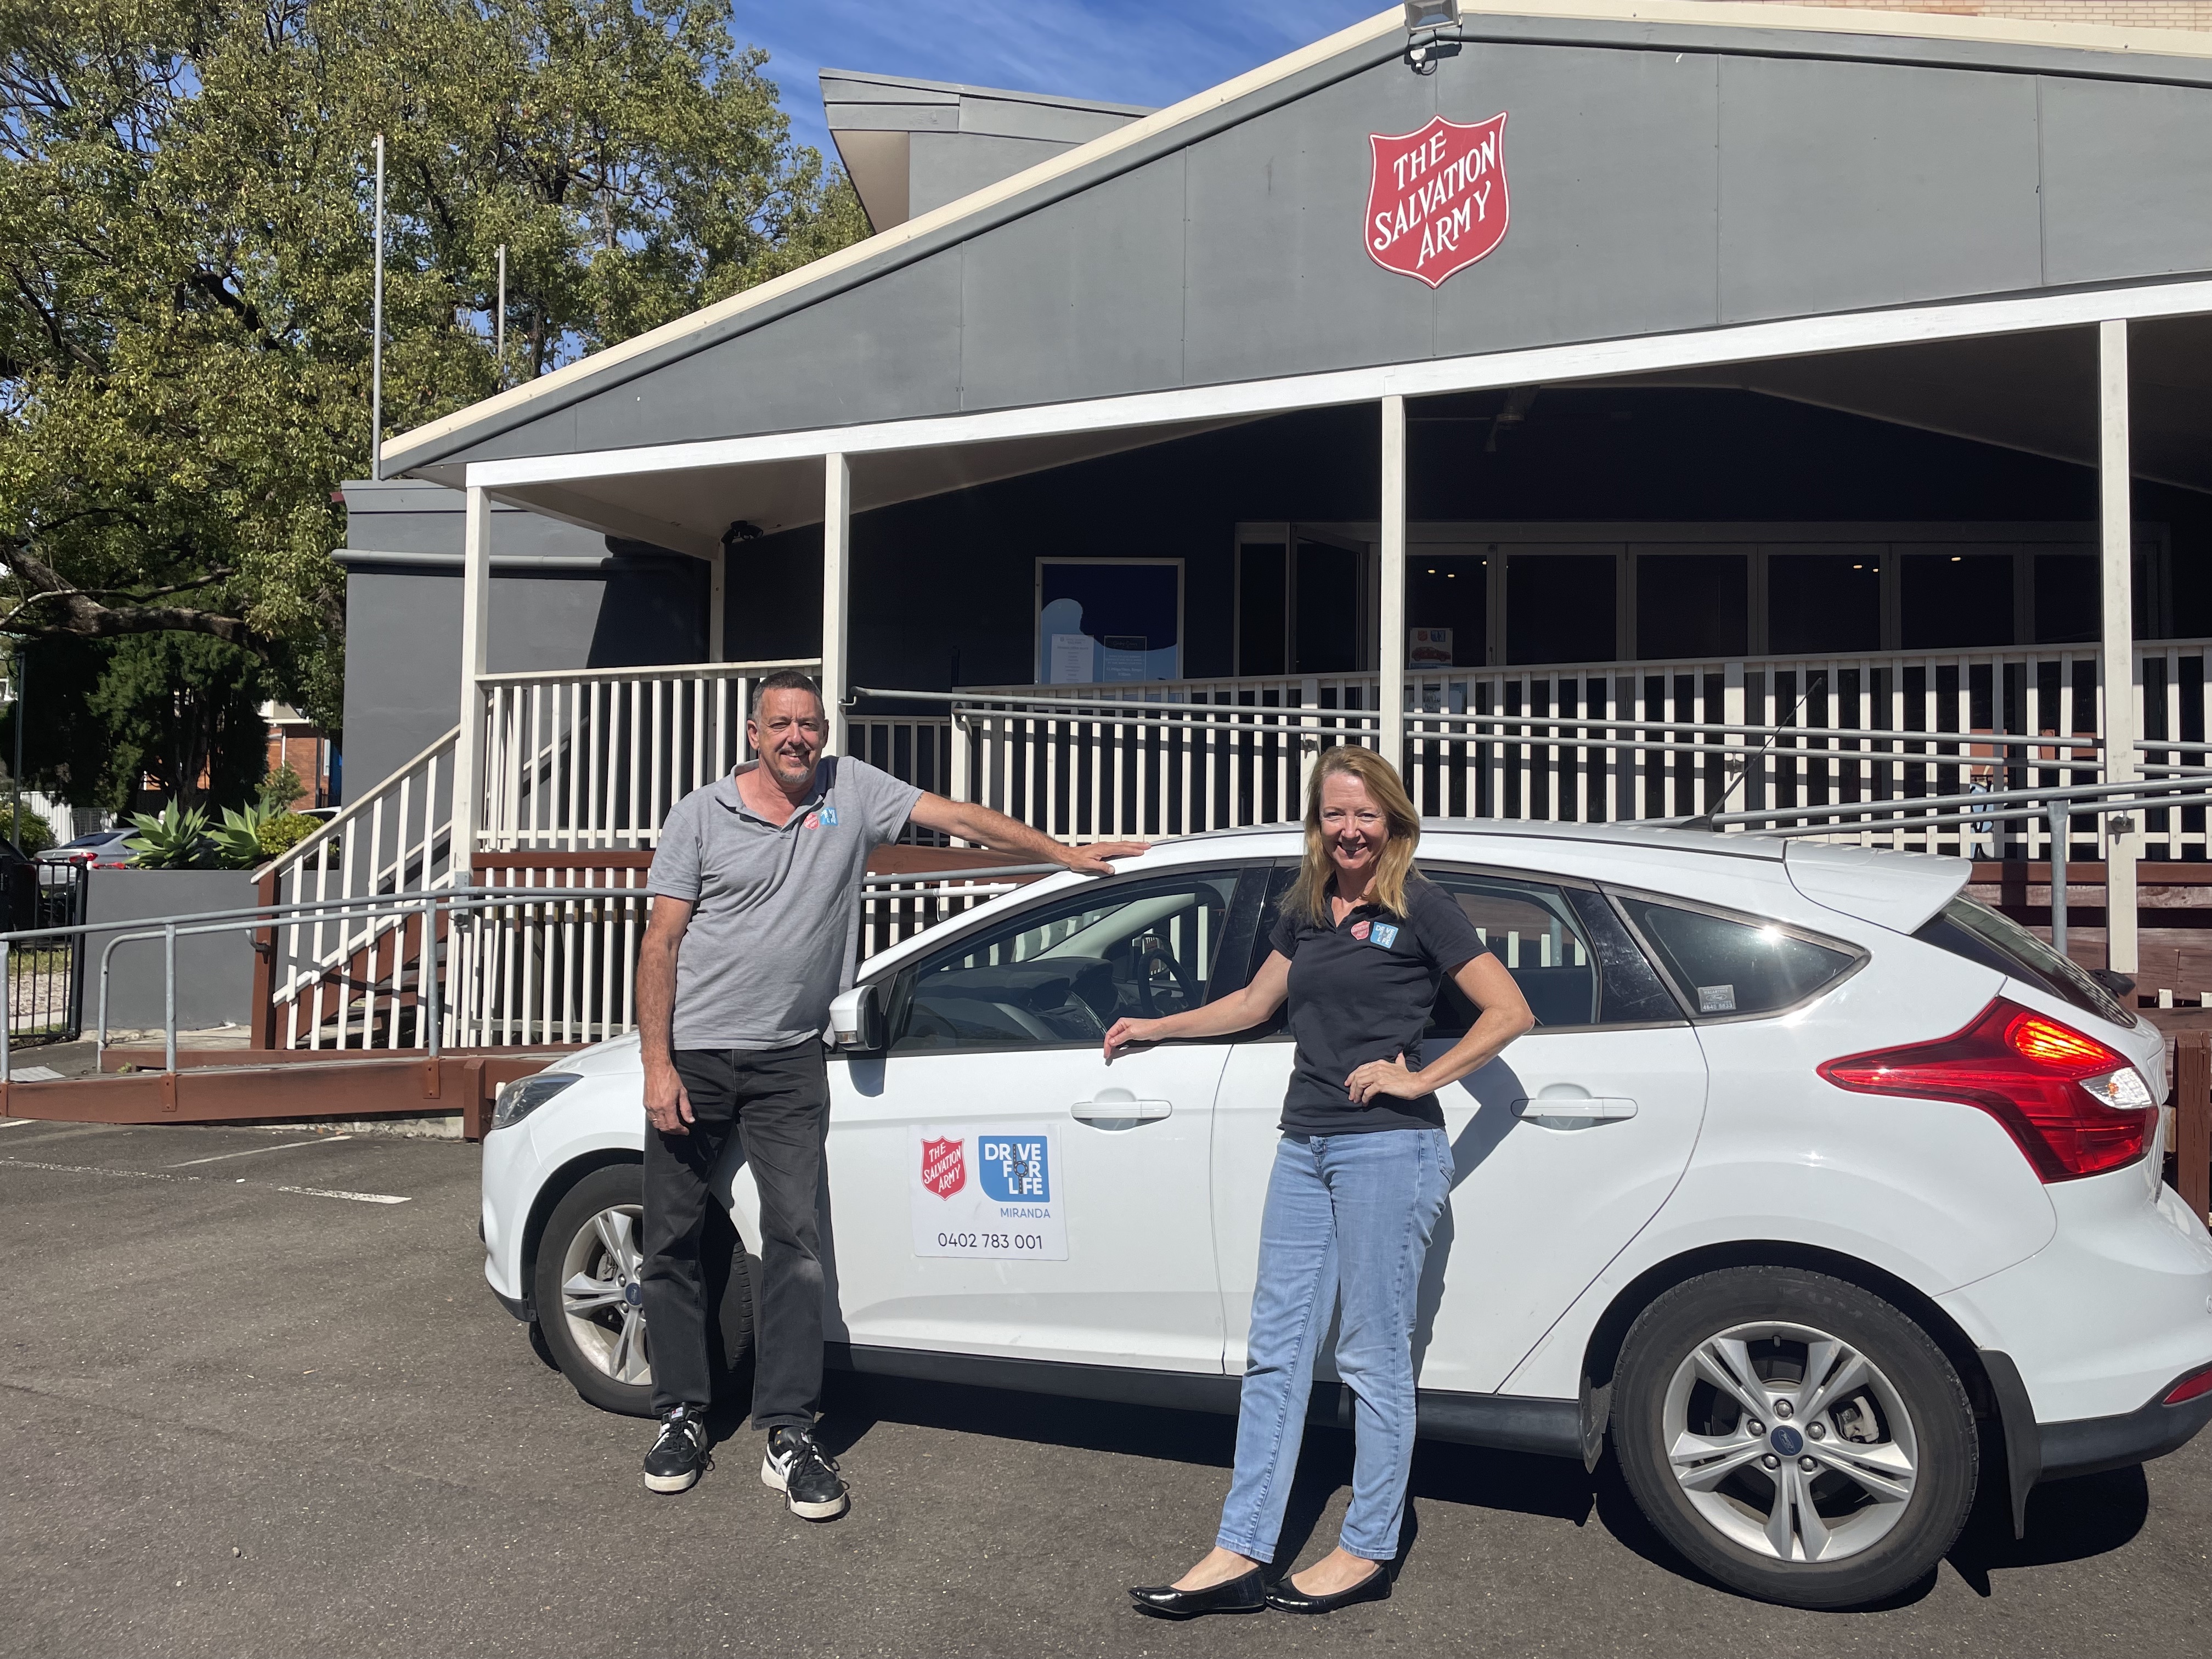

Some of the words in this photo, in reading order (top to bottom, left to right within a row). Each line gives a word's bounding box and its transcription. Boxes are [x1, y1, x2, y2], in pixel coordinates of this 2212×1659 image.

[1393, 129, 1446, 191] THE
[1374, 131, 1495, 250] SALVATION
[1416, 180, 1491, 269] ARMY
[929, 1142, 946, 1162] THE
[985, 1143, 1041, 1161] DRIVE
[924, 1146, 961, 1184] SALVATION
[1003, 1160, 1042, 1177] FOR
[938, 1164, 960, 1193] ARMY
[1008, 1178, 1043, 1194] LIFE
[1001, 1208, 1050, 1218] MIRANDA
[938, 1233, 977, 1248] 0402
[981, 1234, 1009, 1248] 783
[1015, 1235, 1042, 1249] 001
